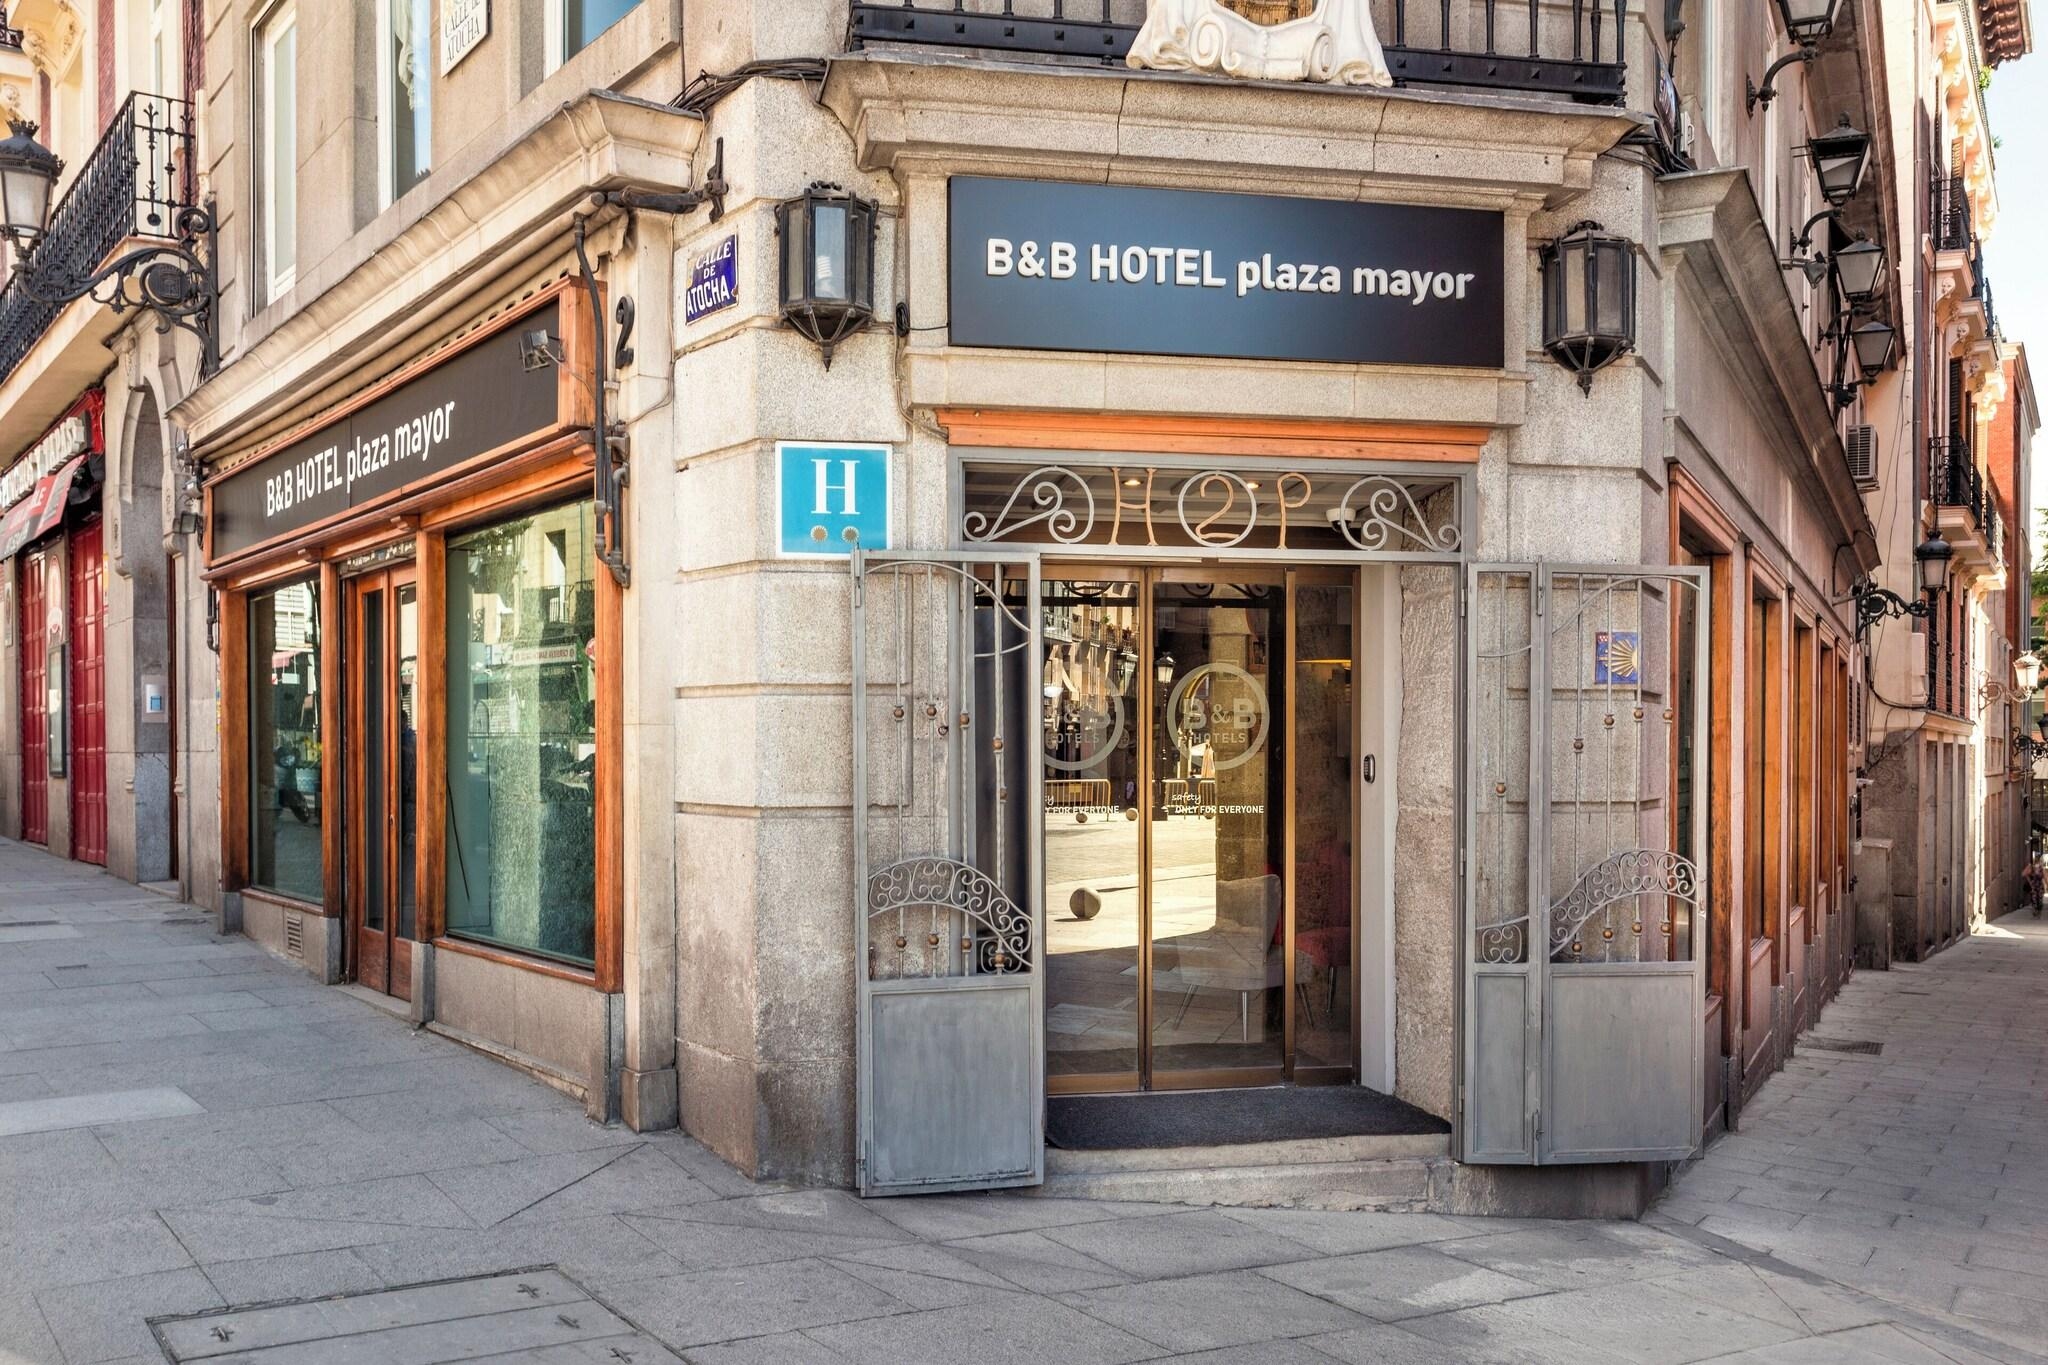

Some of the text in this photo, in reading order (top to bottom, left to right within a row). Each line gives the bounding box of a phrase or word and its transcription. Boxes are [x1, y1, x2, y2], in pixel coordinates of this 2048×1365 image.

[446, 16, 480, 65] ATOCHA
[696, 241, 732, 270] CALLE
[703, 264, 716, 280] DE
[986, 238, 1475, 306] B&B HOTEL plaza mayor
[687, 275, 730, 317] ATOCHA
[266, 400, 456, 518] B&B HOTEL plaza mayor
[810, 458, 861, 516] H
[1193, 733, 1246, 744] HOTELS
[1073, 805, 1120, 815] EVERYONE
[1171, 791, 1202, 805] safety
[1175, 805, 1265, 815] ONLY FOR EVERYONE
